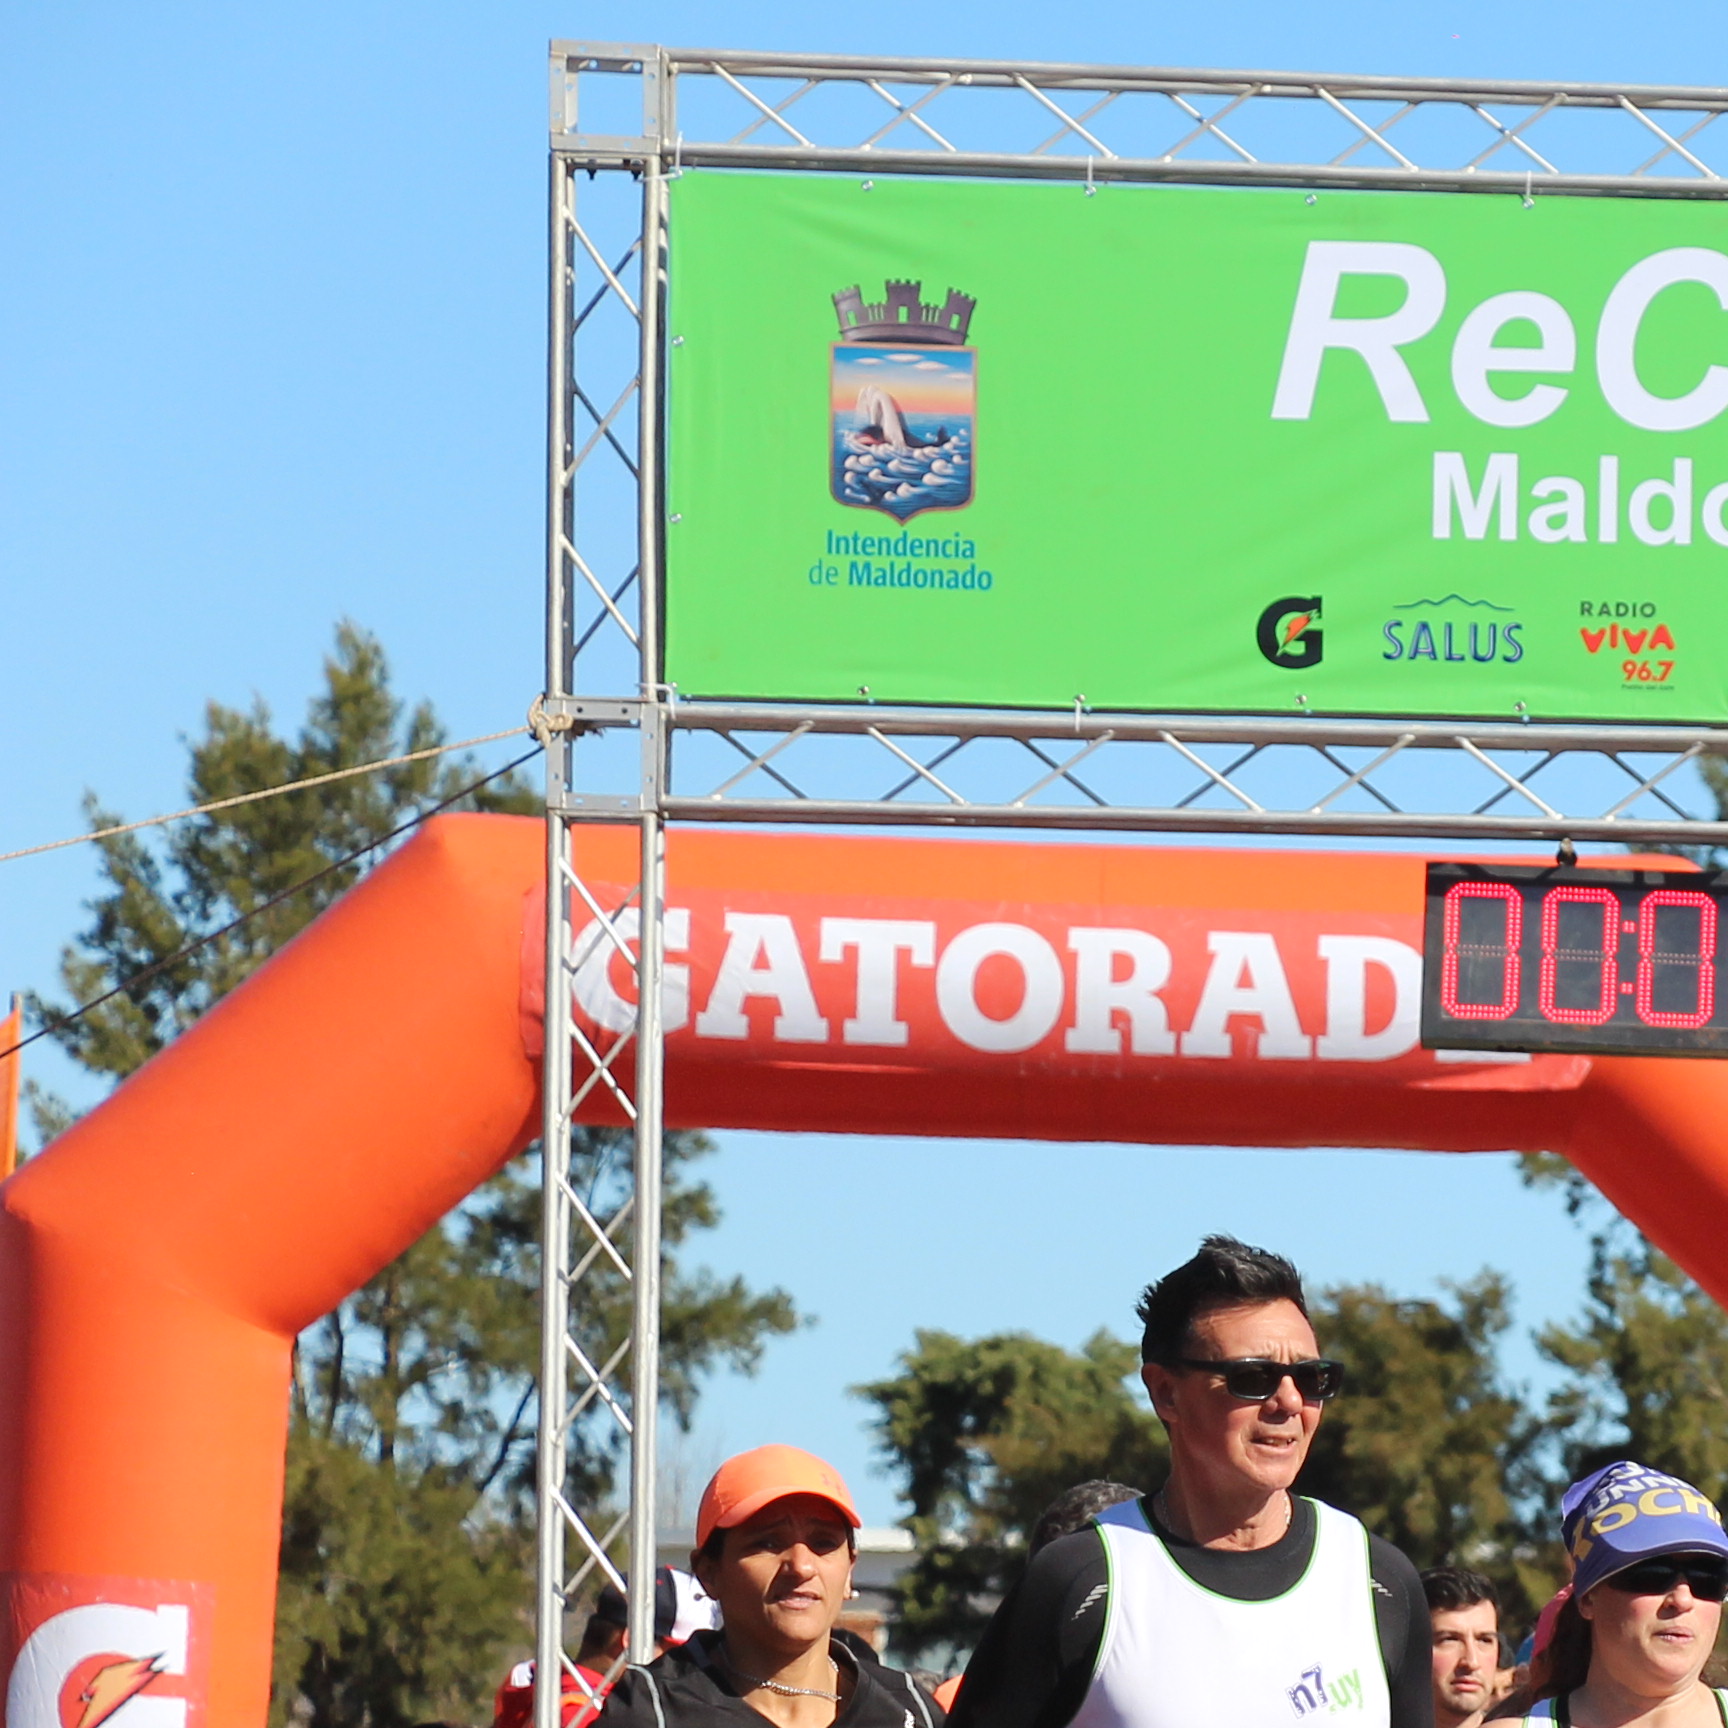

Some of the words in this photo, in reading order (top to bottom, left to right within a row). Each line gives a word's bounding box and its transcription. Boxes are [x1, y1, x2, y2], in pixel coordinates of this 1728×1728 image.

[826, 529, 976, 559] Intendencia
[808, 559, 839, 586] de
[848, 561, 993, 591] Maldonado
[1580, 601, 1656, 618] RADIO
[1382, 620, 1524, 663] SALUS
[1580, 622, 1675, 655] VIVA
[1622, 660, 1675, 681] 96.7
[571, 907, 1424, 1062] GATORAD
